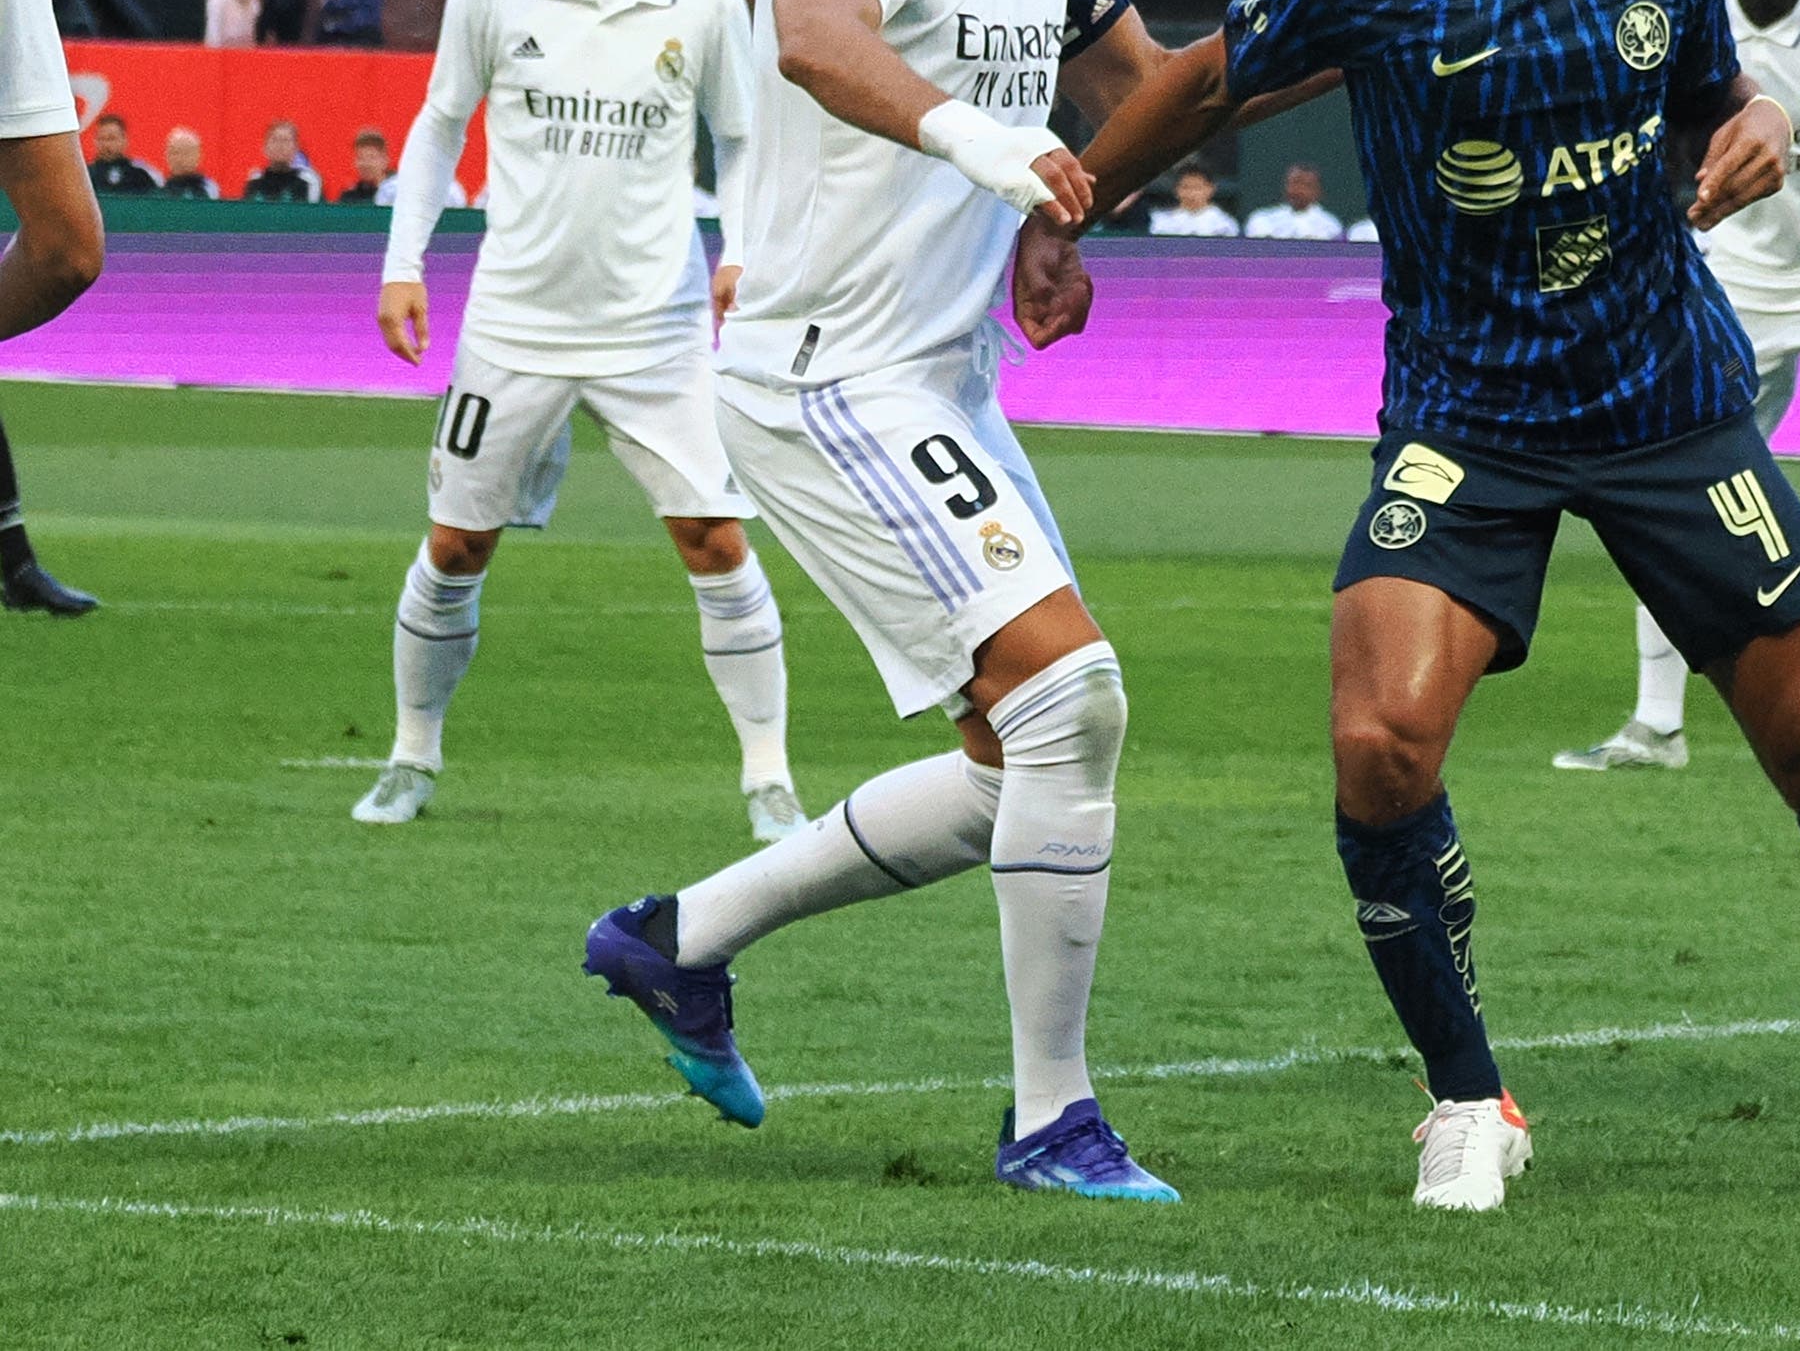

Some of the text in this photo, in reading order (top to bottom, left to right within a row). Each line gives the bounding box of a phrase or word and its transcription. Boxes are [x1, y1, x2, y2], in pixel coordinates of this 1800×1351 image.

[524, 87, 671, 129] Emirates
[545, 126, 647, 160] FLY BETTER
[909, 433, 998, 520] 9
[1706, 469, 1790, 563] 4
